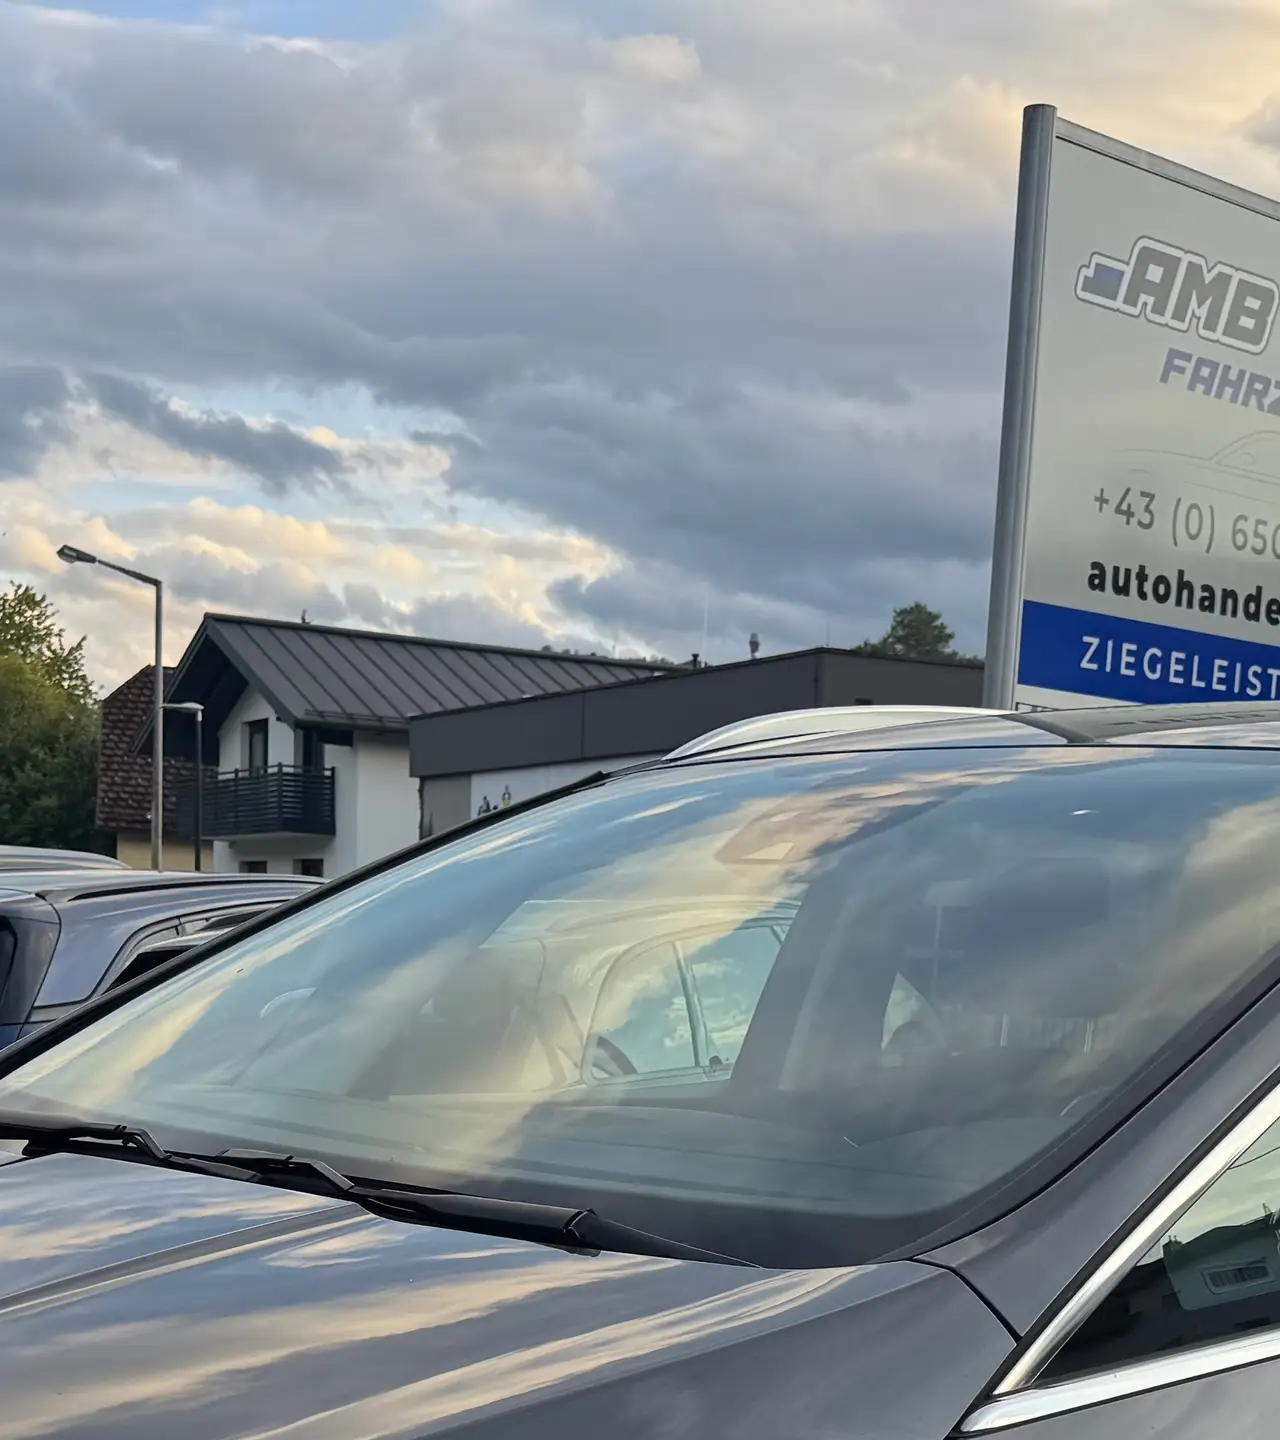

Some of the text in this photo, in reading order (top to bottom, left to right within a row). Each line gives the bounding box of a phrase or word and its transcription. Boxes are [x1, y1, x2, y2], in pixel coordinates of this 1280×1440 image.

[1122, 243, 1278, 352] AMB
[1093, 487, 1156, 530] +43
[1172, 496, 1217, 554] (0)
